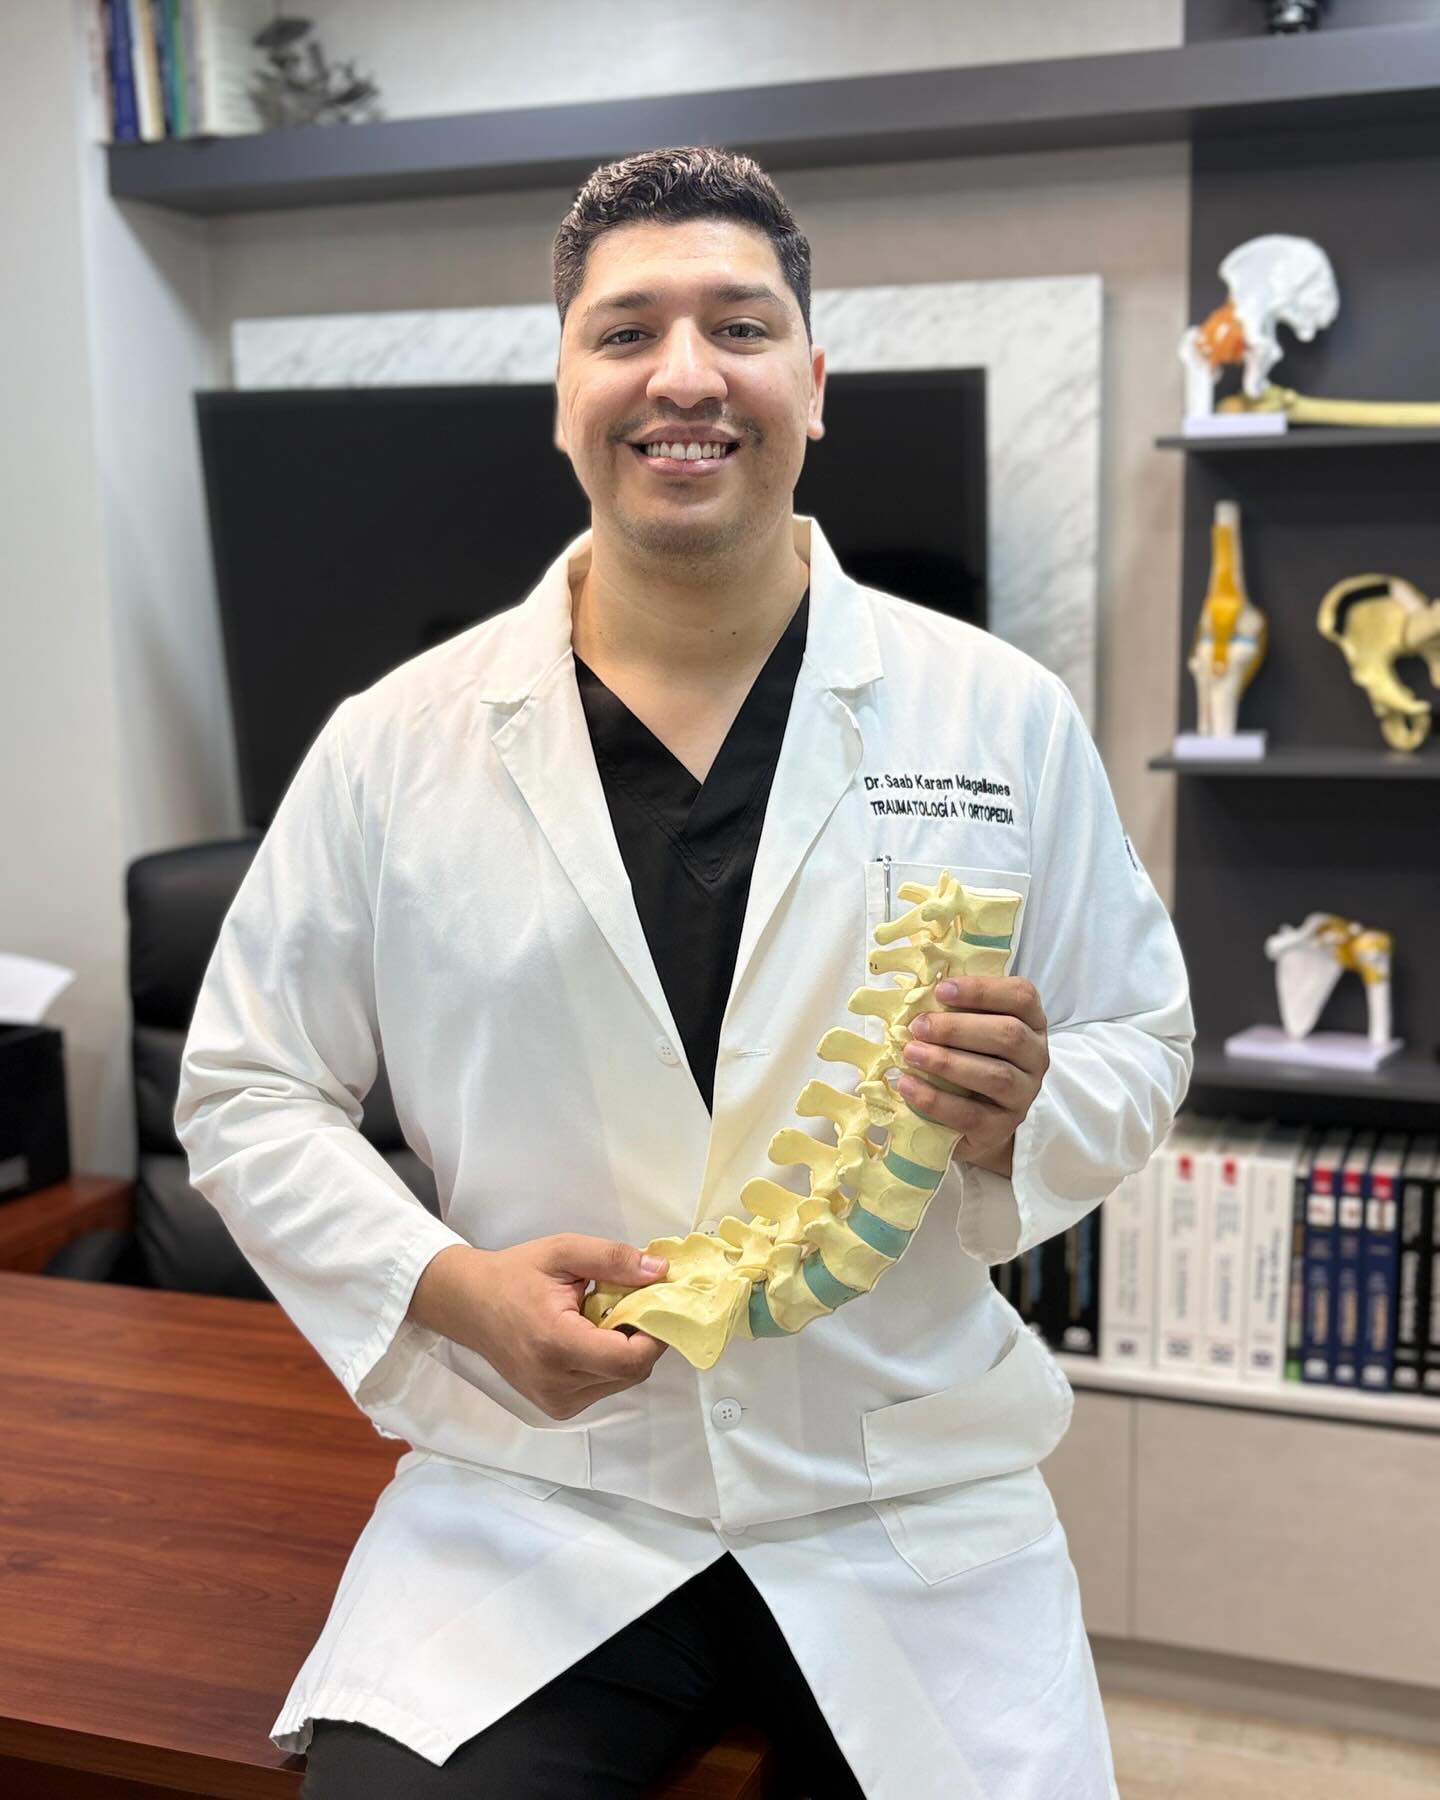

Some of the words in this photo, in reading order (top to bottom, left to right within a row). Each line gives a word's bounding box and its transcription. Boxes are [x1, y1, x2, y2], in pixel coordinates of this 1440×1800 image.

[864, 776, 884, 790] Dr.
[885, 774, 913, 789] Saab
[915, 775, 954, 790] Karam
[955, 774, 1011, 796] Magallanes
[960, 801, 967, 816] Y
[968, 803, 1014, 825] ORTOPEDIA
